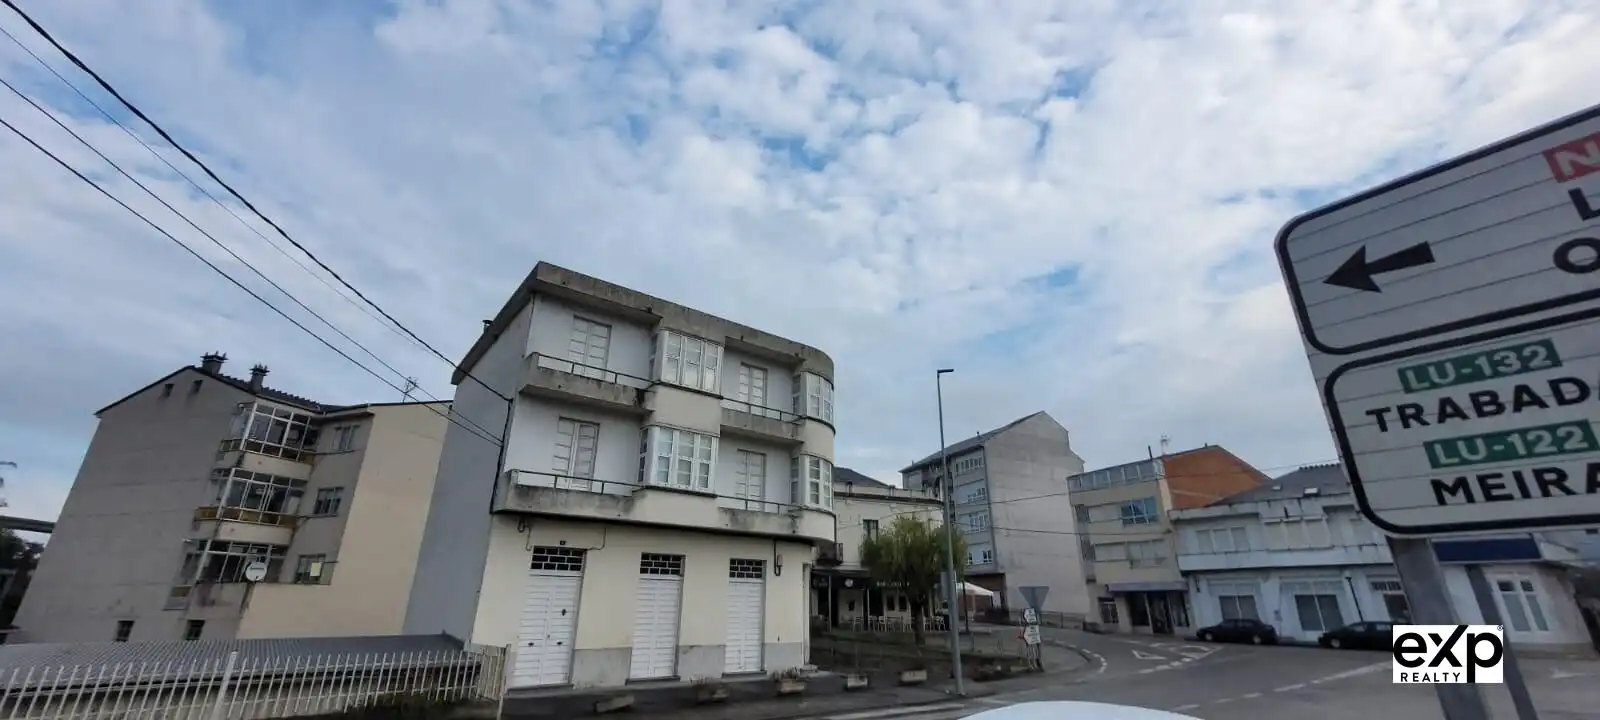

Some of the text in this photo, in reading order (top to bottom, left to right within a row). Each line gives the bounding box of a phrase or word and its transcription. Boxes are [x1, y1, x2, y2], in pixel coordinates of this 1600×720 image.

[1405, 345, 1552, 390] LU-132
[1365, 370, 1600, 432] TRABAD
[1433, 425, 1588, 464] LU-122
